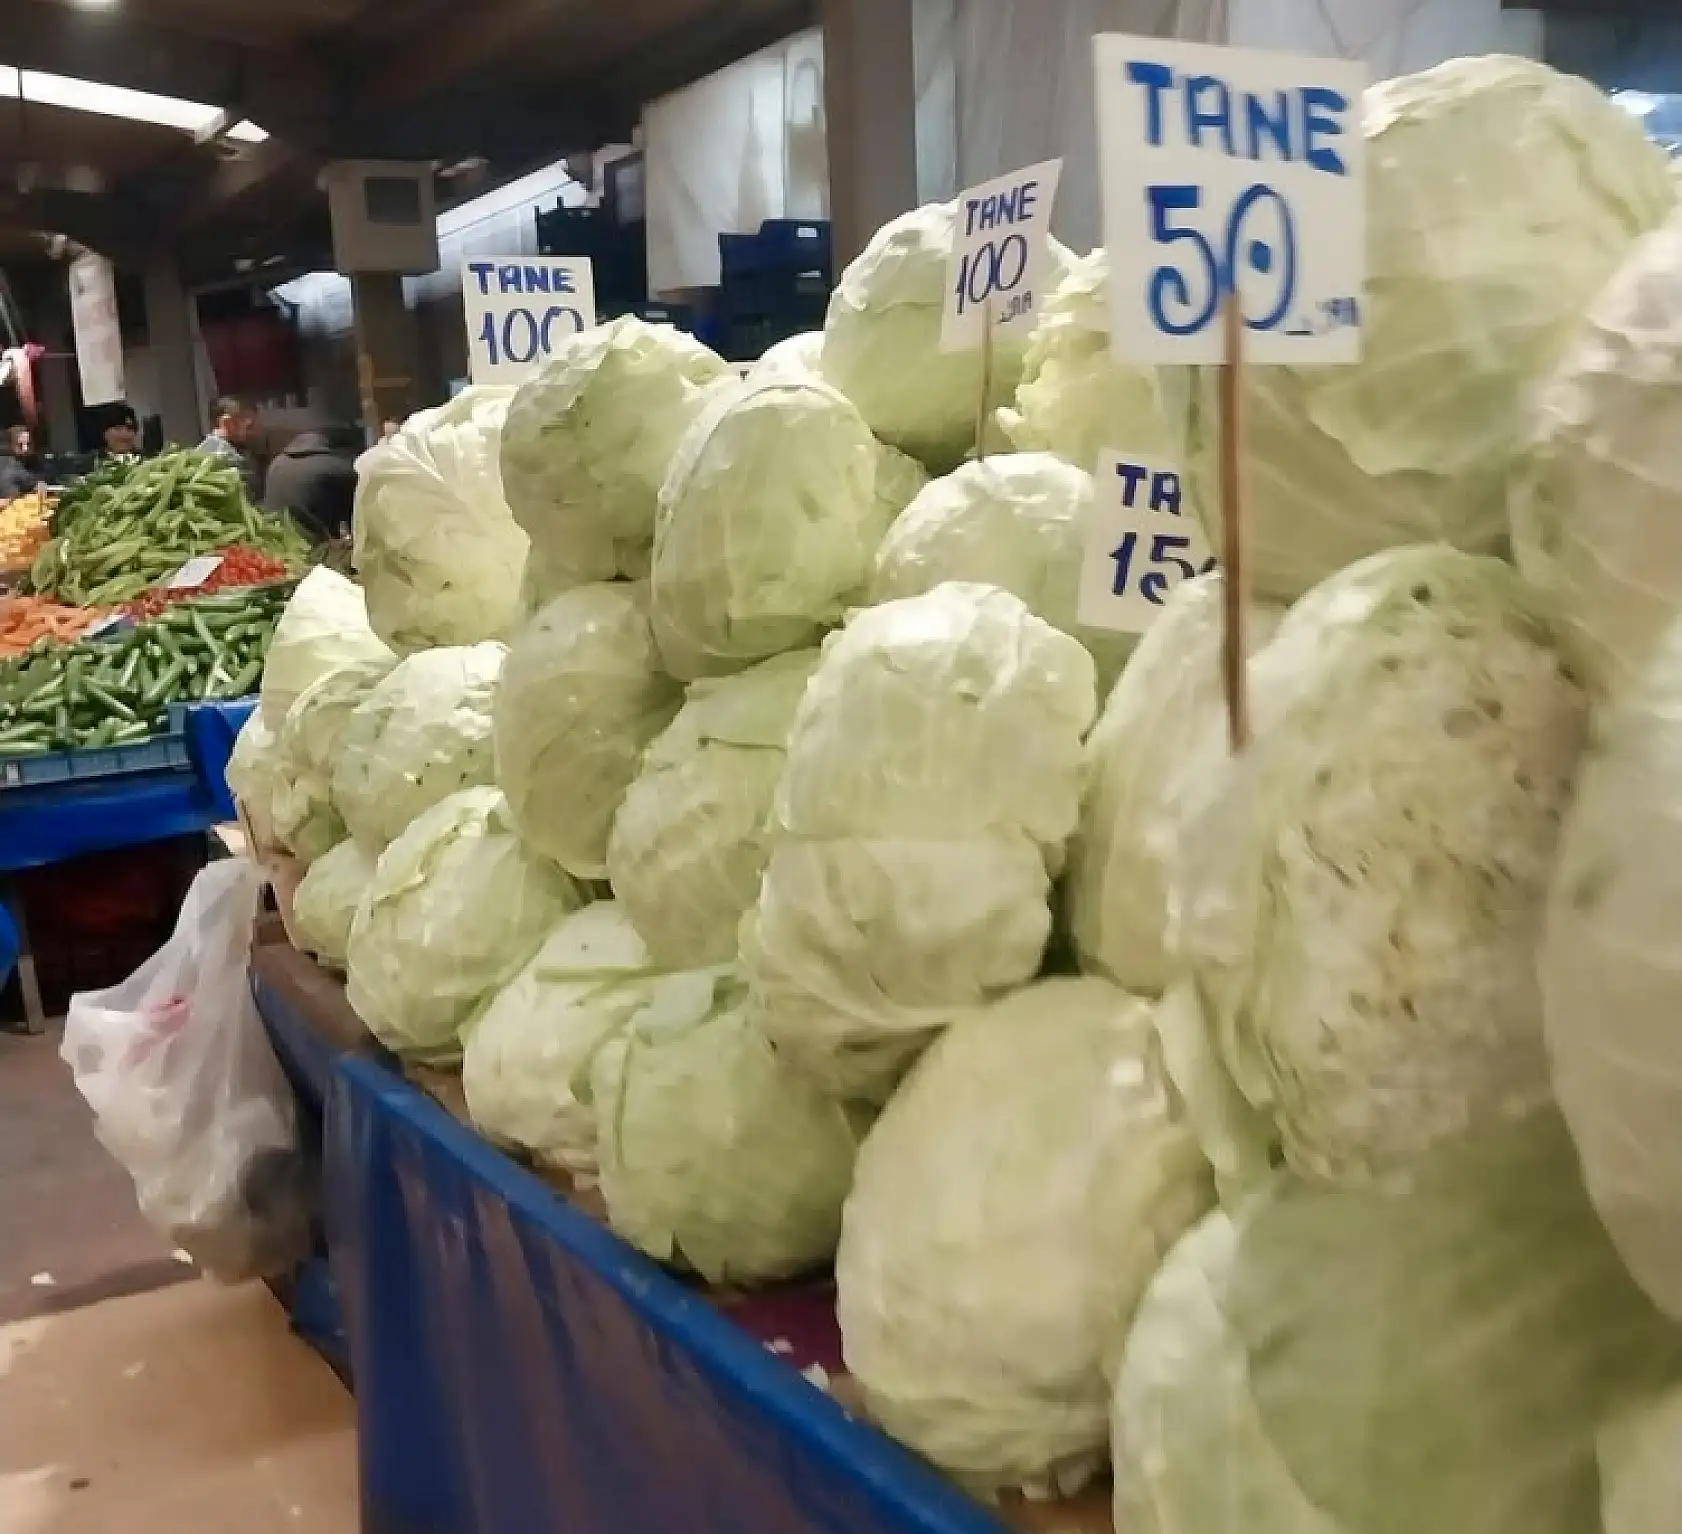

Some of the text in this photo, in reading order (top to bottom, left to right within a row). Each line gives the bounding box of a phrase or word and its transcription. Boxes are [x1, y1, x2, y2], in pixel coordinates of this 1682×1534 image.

[1123, 61, 1349, 176] TANE
[966, 180, 1038, 237] TANE
[468, 263, 576, 295] TANE
[955, 234, 1028, 315] 100
[1146, 182, 1295, 336] 50
[1109, 531, 1218, 606] 15
